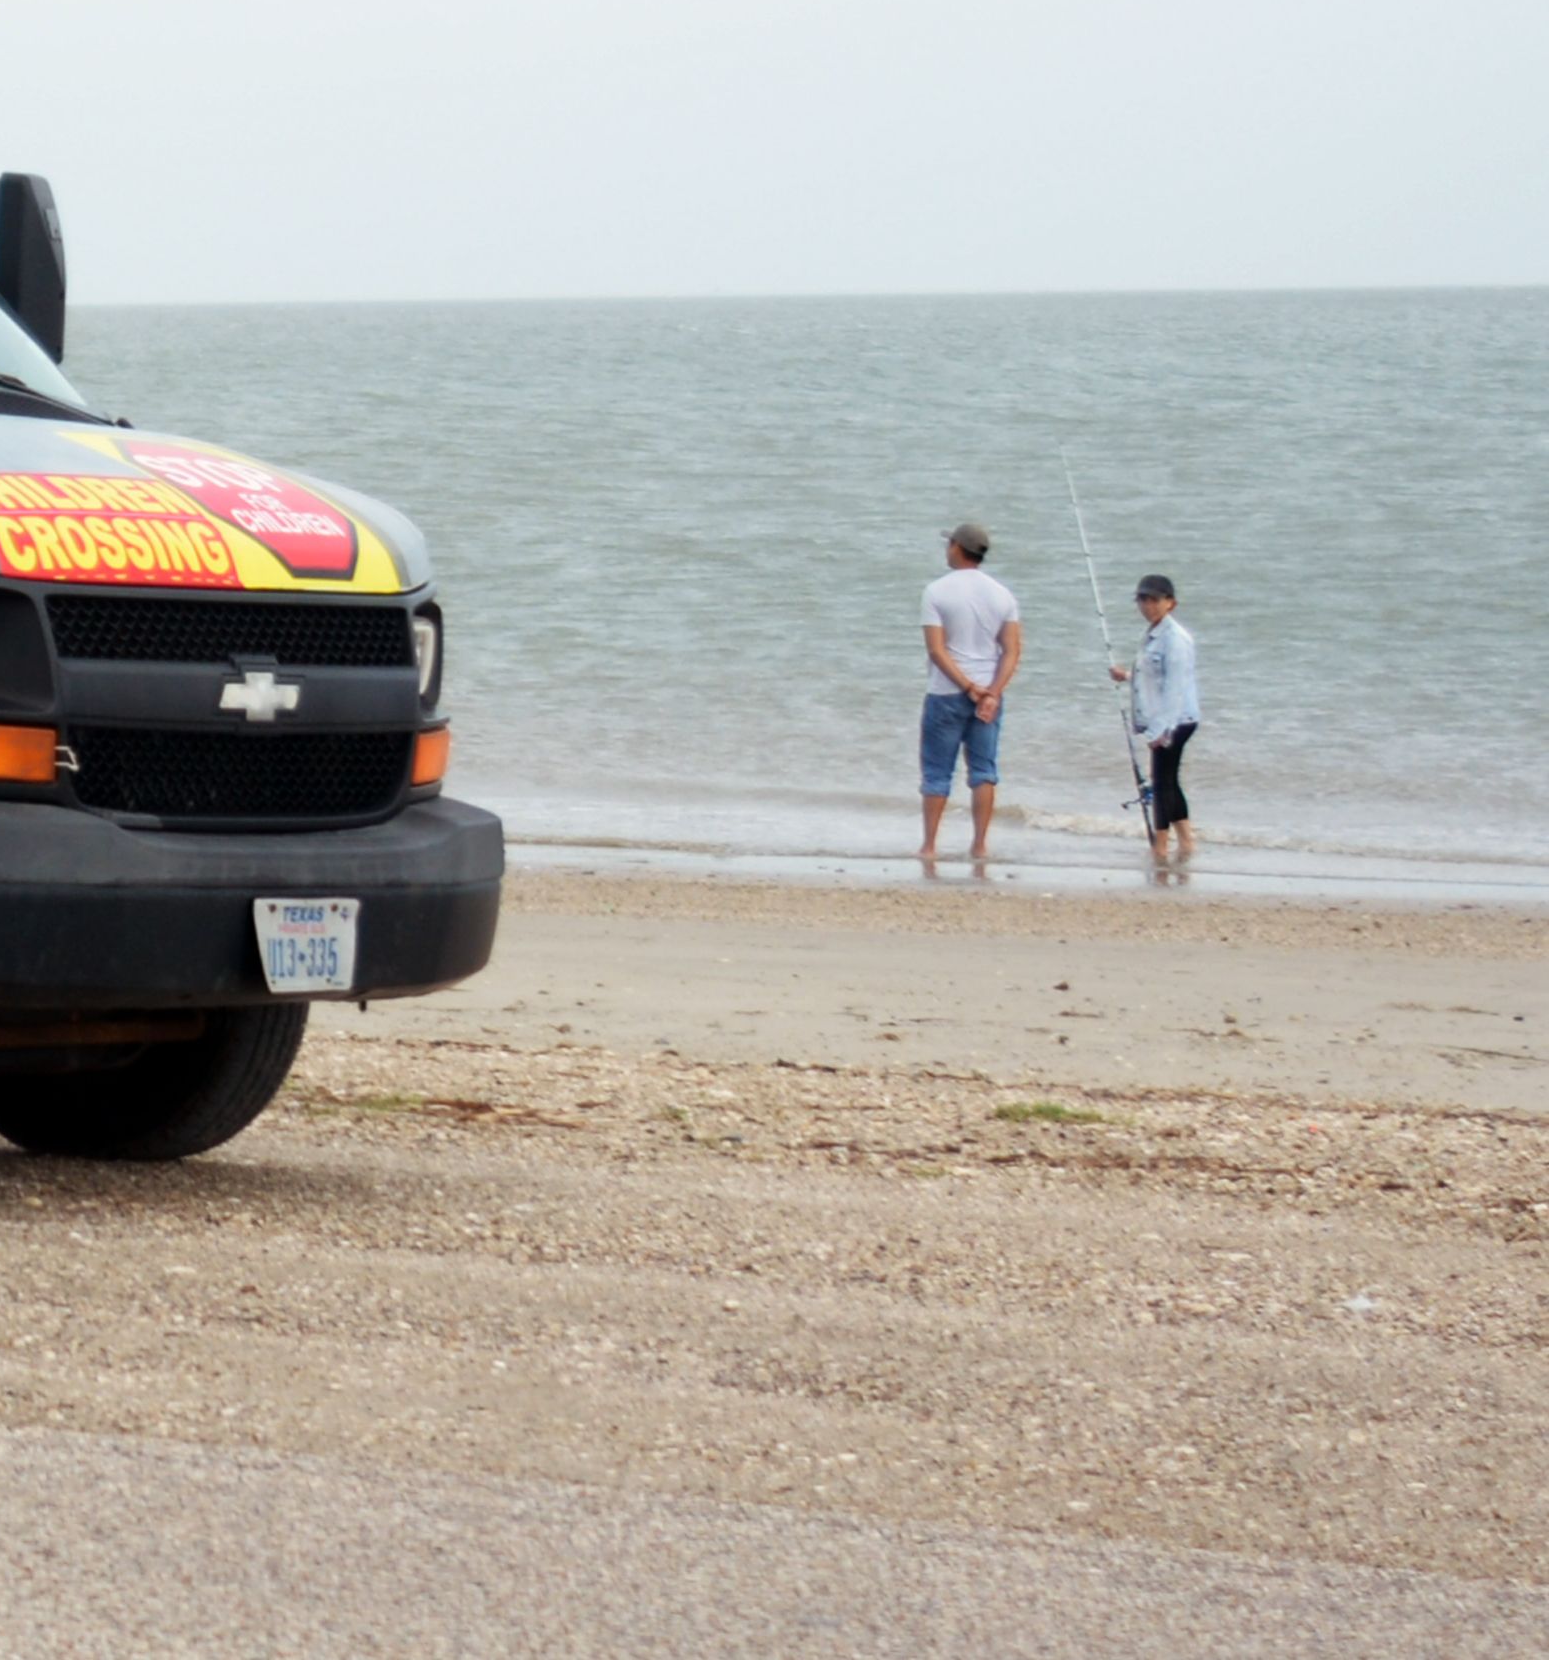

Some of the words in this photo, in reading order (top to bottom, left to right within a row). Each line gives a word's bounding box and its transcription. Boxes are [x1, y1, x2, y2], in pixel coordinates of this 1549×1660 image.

[132, 453, 282, 493] STOP
[238, 493, 292, 513] FOR
[230, 508, 346, 538] CHILDREN
[283, 906, 326, 923] TEXAS
